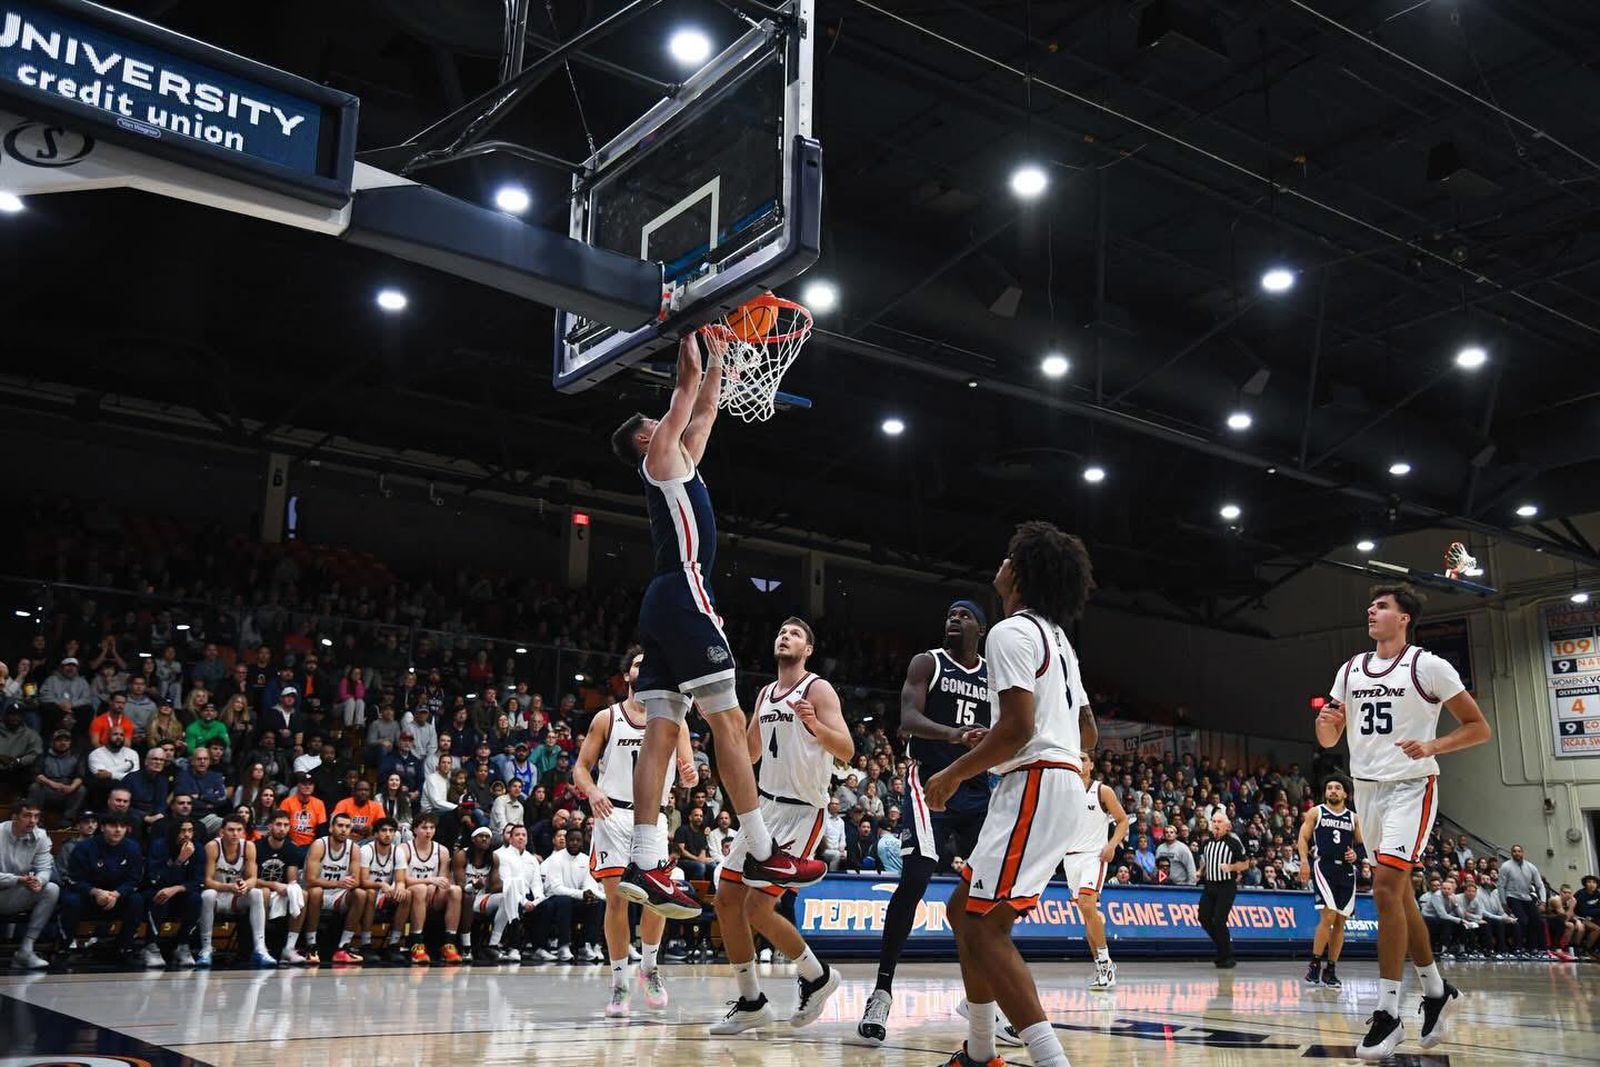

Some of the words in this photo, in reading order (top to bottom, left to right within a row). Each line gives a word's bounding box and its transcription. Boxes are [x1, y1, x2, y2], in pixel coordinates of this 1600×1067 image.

[18, 64, 133, 117] credit
[148, 105, 244, 152] union
[1554, 639, 1590, 656] 109
[1558, 661, 1570, 672] 9
[1558, 688, 1598, 696] OLYMPIANS
[956, 699, 977, 725] 15
[1571, 699, 1584, 713] 4
[1360, 702, 1392, 735] 35
[1565, 723, 1577, 733] 9
[1332, 829, 1341, 844] 3
[1107, 902, 1168, 926] GAME
[1167, 903, 1274, 928] PRENTED
[1273, 906, 1297, 928] BY
